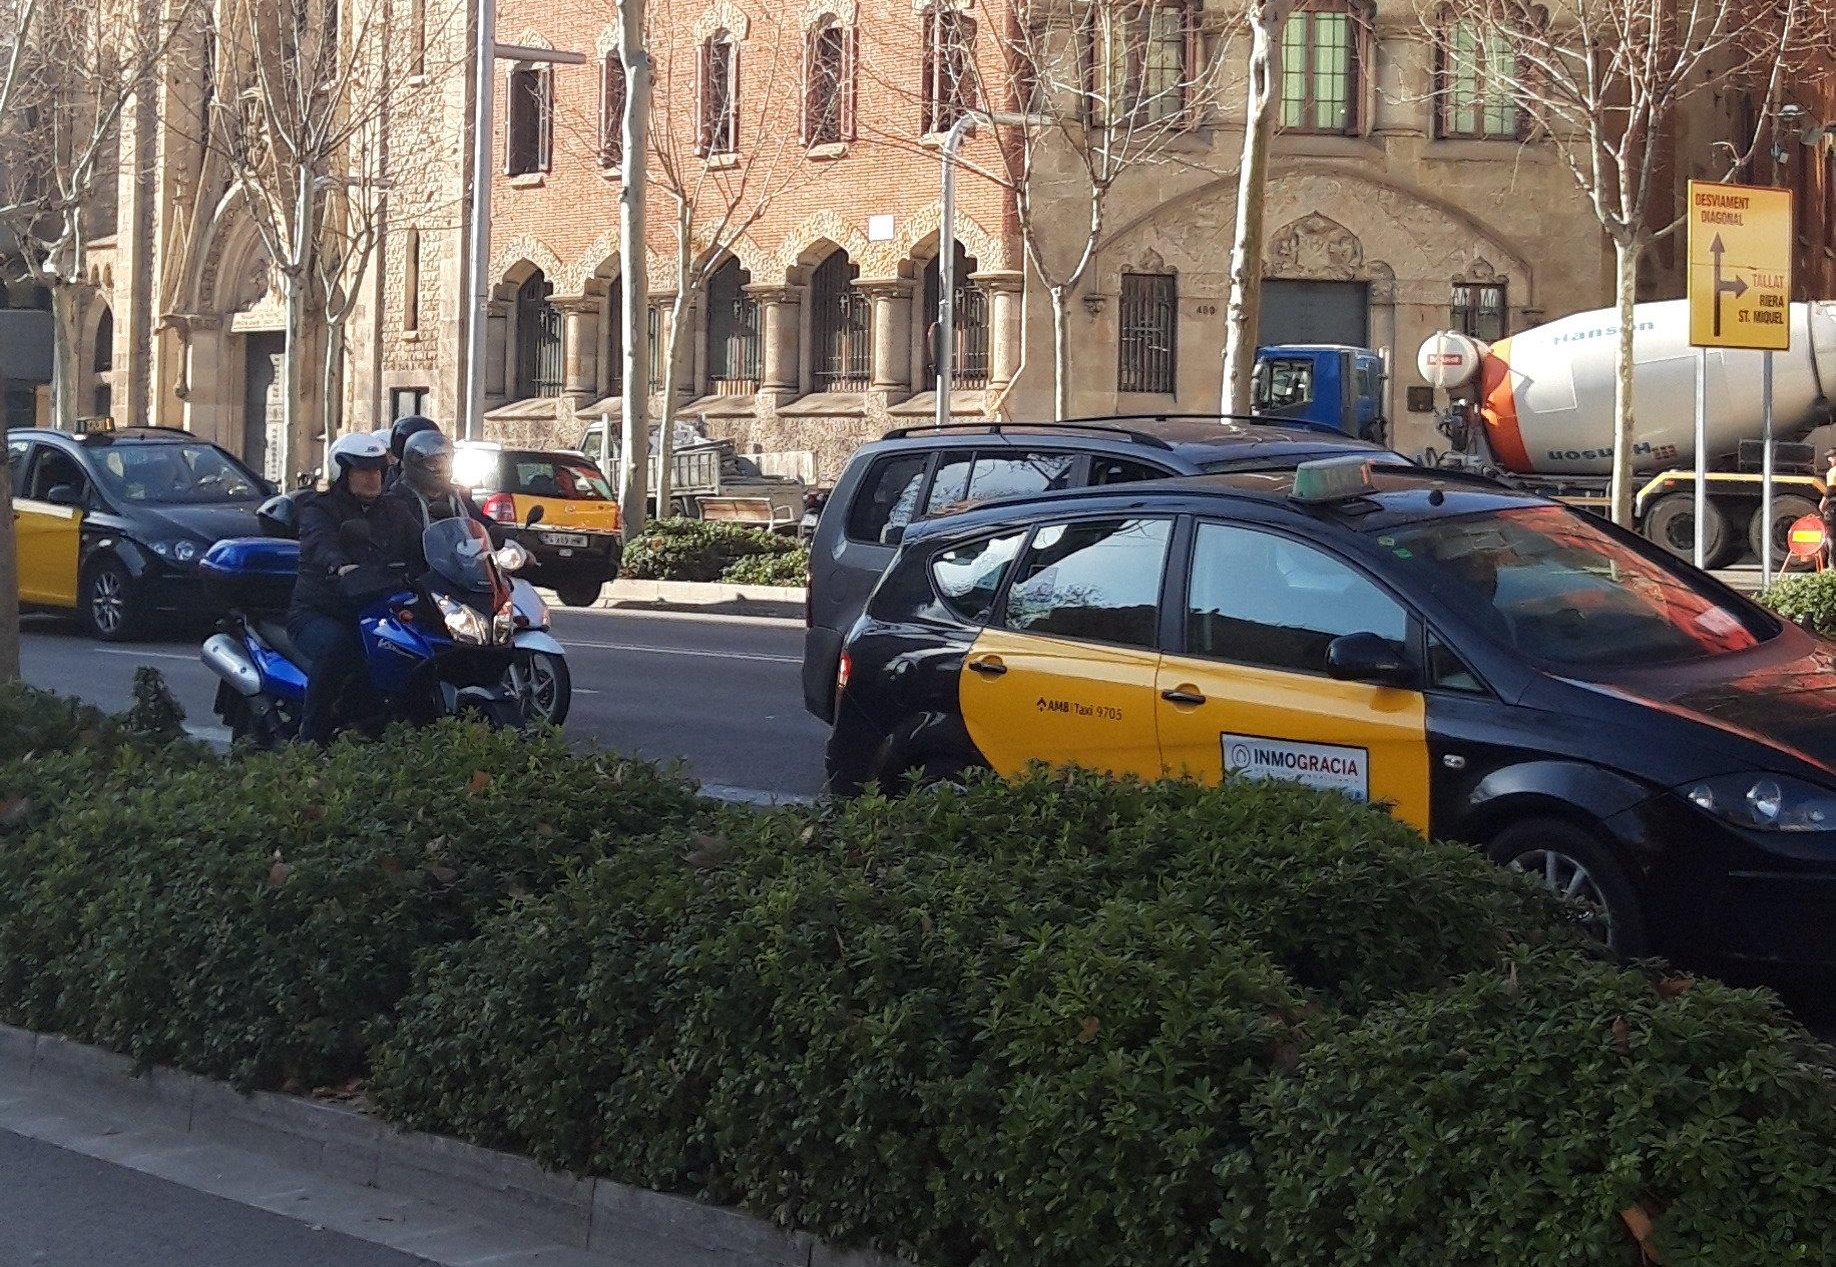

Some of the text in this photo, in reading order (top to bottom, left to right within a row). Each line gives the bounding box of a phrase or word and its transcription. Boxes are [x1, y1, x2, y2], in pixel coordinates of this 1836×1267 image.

[1695, 192, 1750, 210] DESVIAMENT
[1700, 210, 1744, 227] DIAGONAL
[1752, 273, 1785, 289] TALLAT
[1759, 294, 1785, 308] RIERA
[1753, 310, 1784, 325] MIQUEL
[1548, 441, 1652, 461] Hnson
[1074, 702, 1094, 716] Taxi
[1096, 705, 1122, 721] 9705
[1253, 747, 1359, 777] INMOGRACIA
